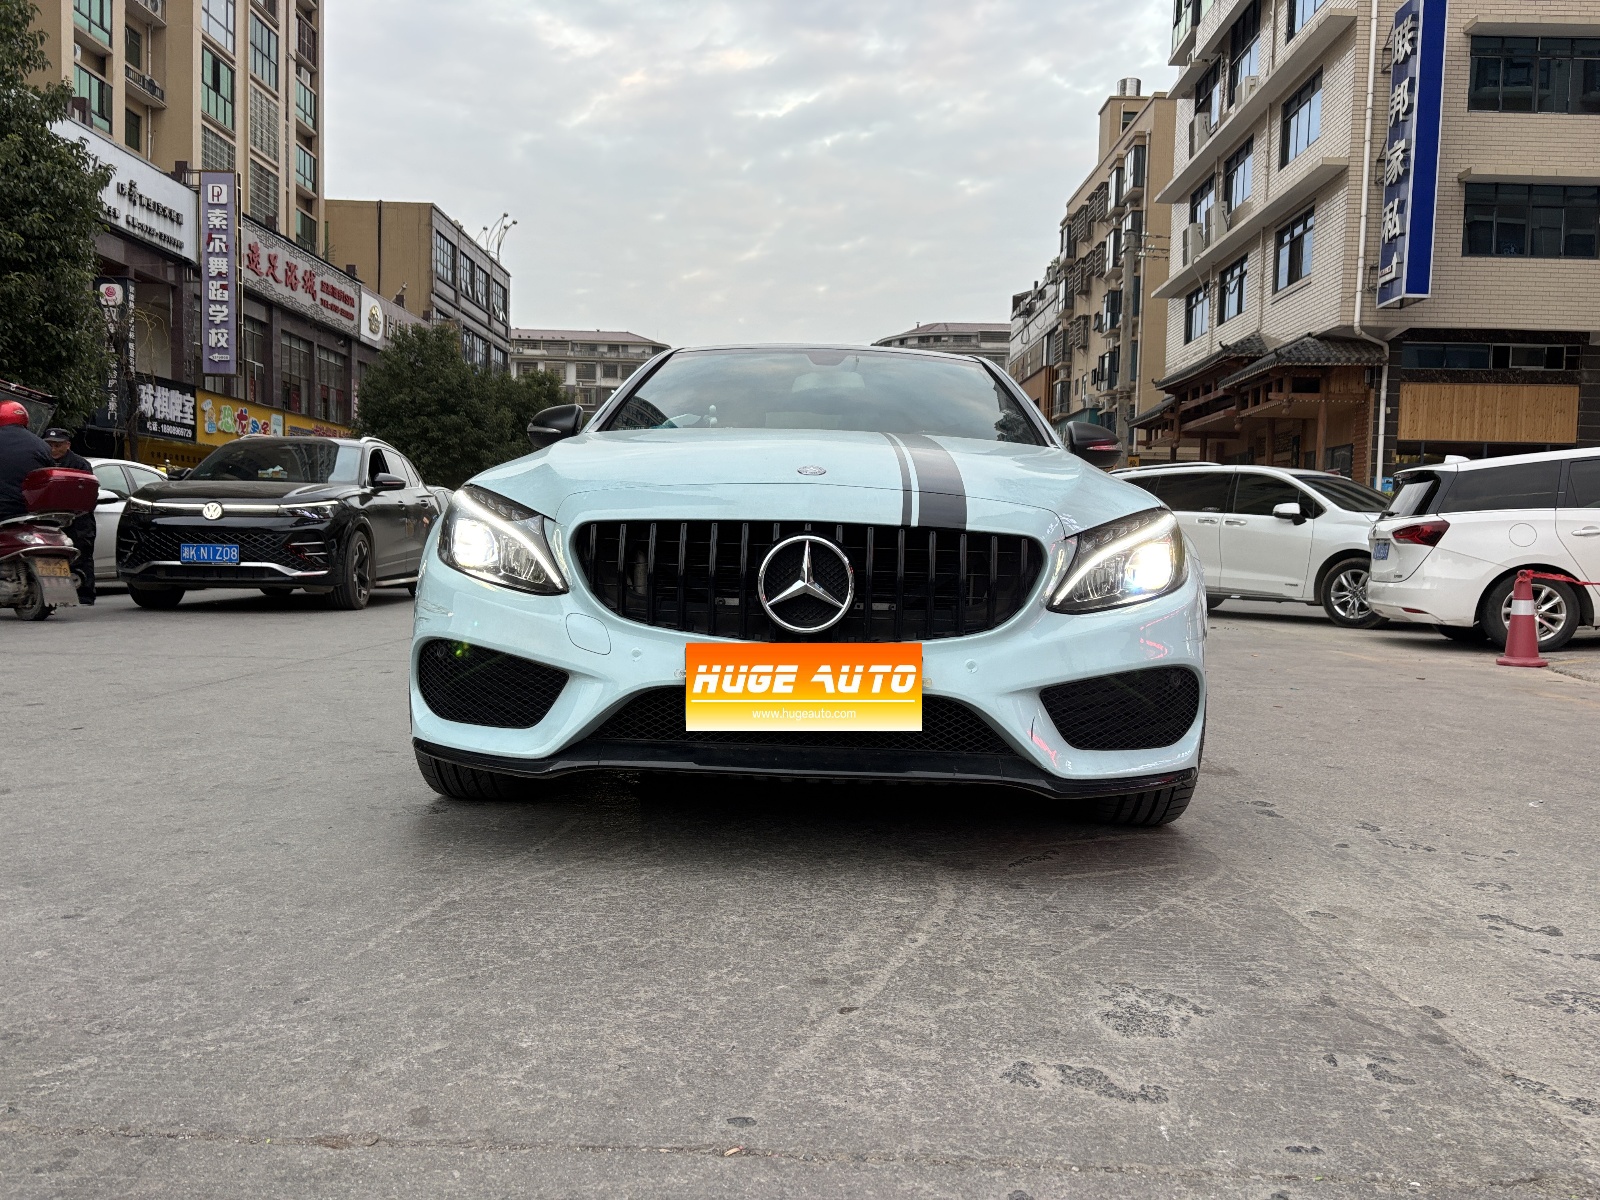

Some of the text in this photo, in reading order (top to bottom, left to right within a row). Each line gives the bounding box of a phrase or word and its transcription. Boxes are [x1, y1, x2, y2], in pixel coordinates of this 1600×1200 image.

[1381, 13, 1418, 245] 联邦家私
[206, 209, 230, 348] 索尔舞蹈学校
